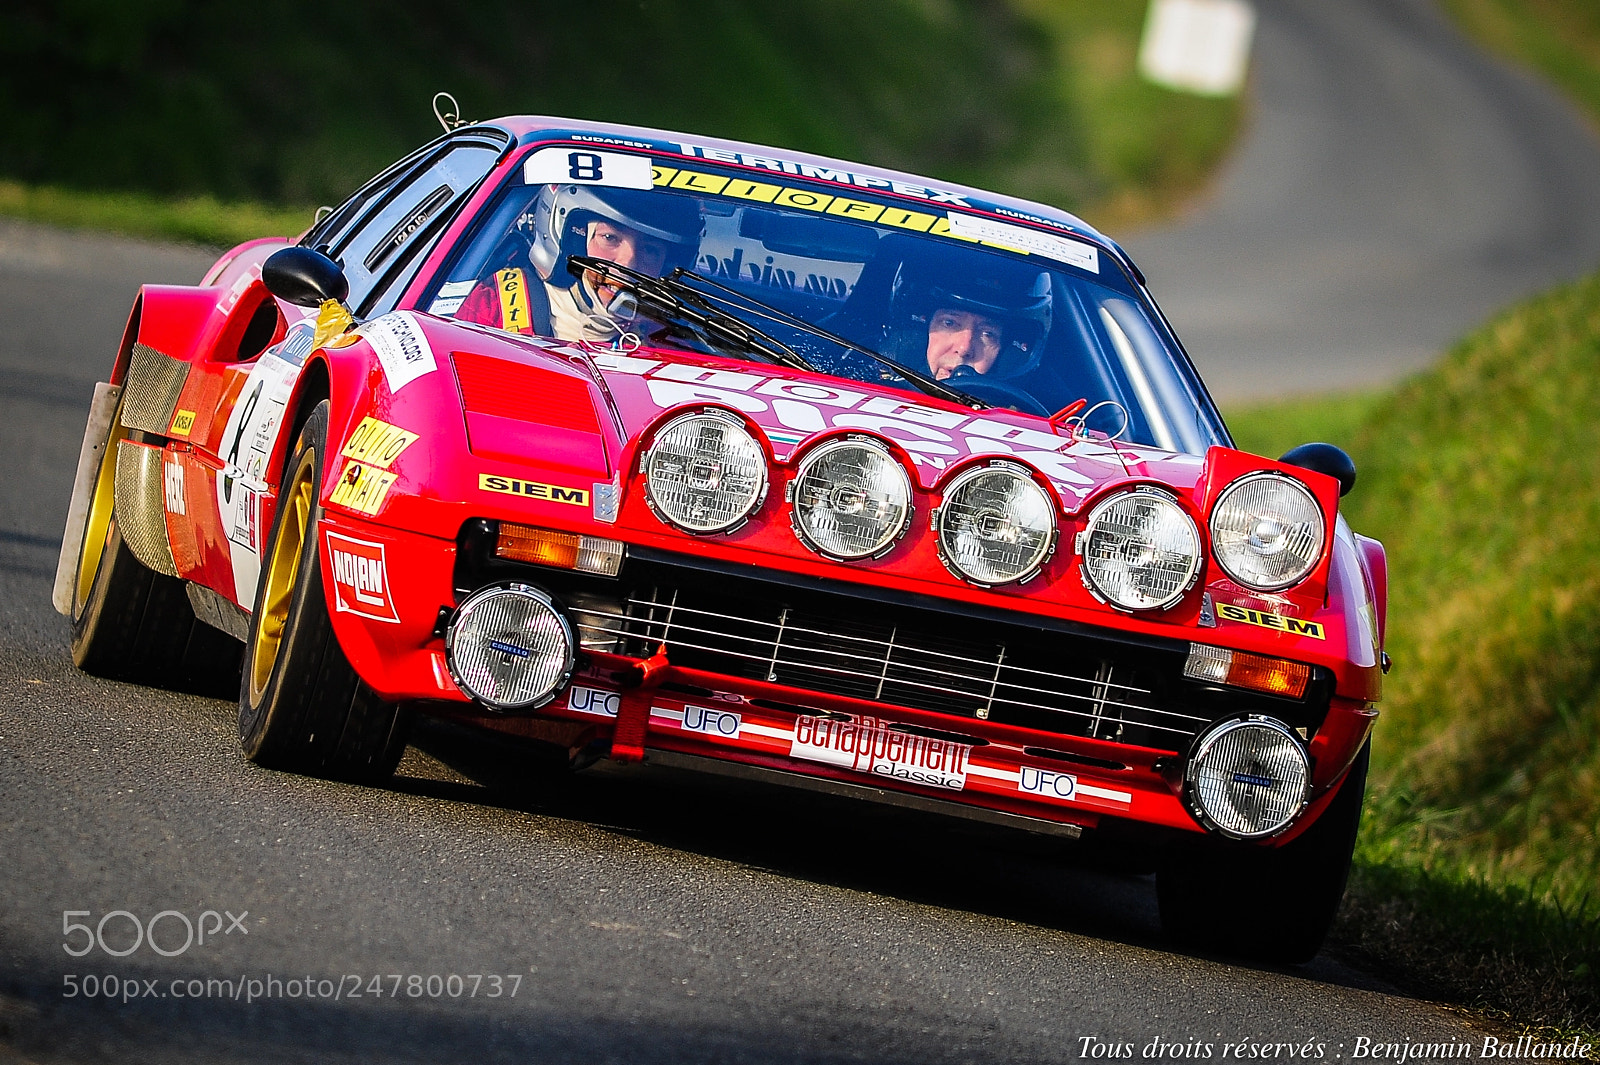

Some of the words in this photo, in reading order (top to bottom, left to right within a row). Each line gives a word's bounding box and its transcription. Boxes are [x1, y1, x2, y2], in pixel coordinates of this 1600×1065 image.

[571, 135, 653, 149] BUDAPEST
[567, 152, 603, 181] 8
[669, 141, 972, 208] TERIMPEX
[995, 208, 1075, 231] HUNGARY
[349, 424, 407, 461] OLIO
[485, 477, 583, 503] SIEM
[333, 550, 385, 607] NOLAN
[1223, 606, 1320, 637] SIEM
[570, 687, 620, 716] UFO
[684, 706, 738, 736] UFO
[873, 763, 963, 789] classic
[1021, 767, 1074, 797] UFO
